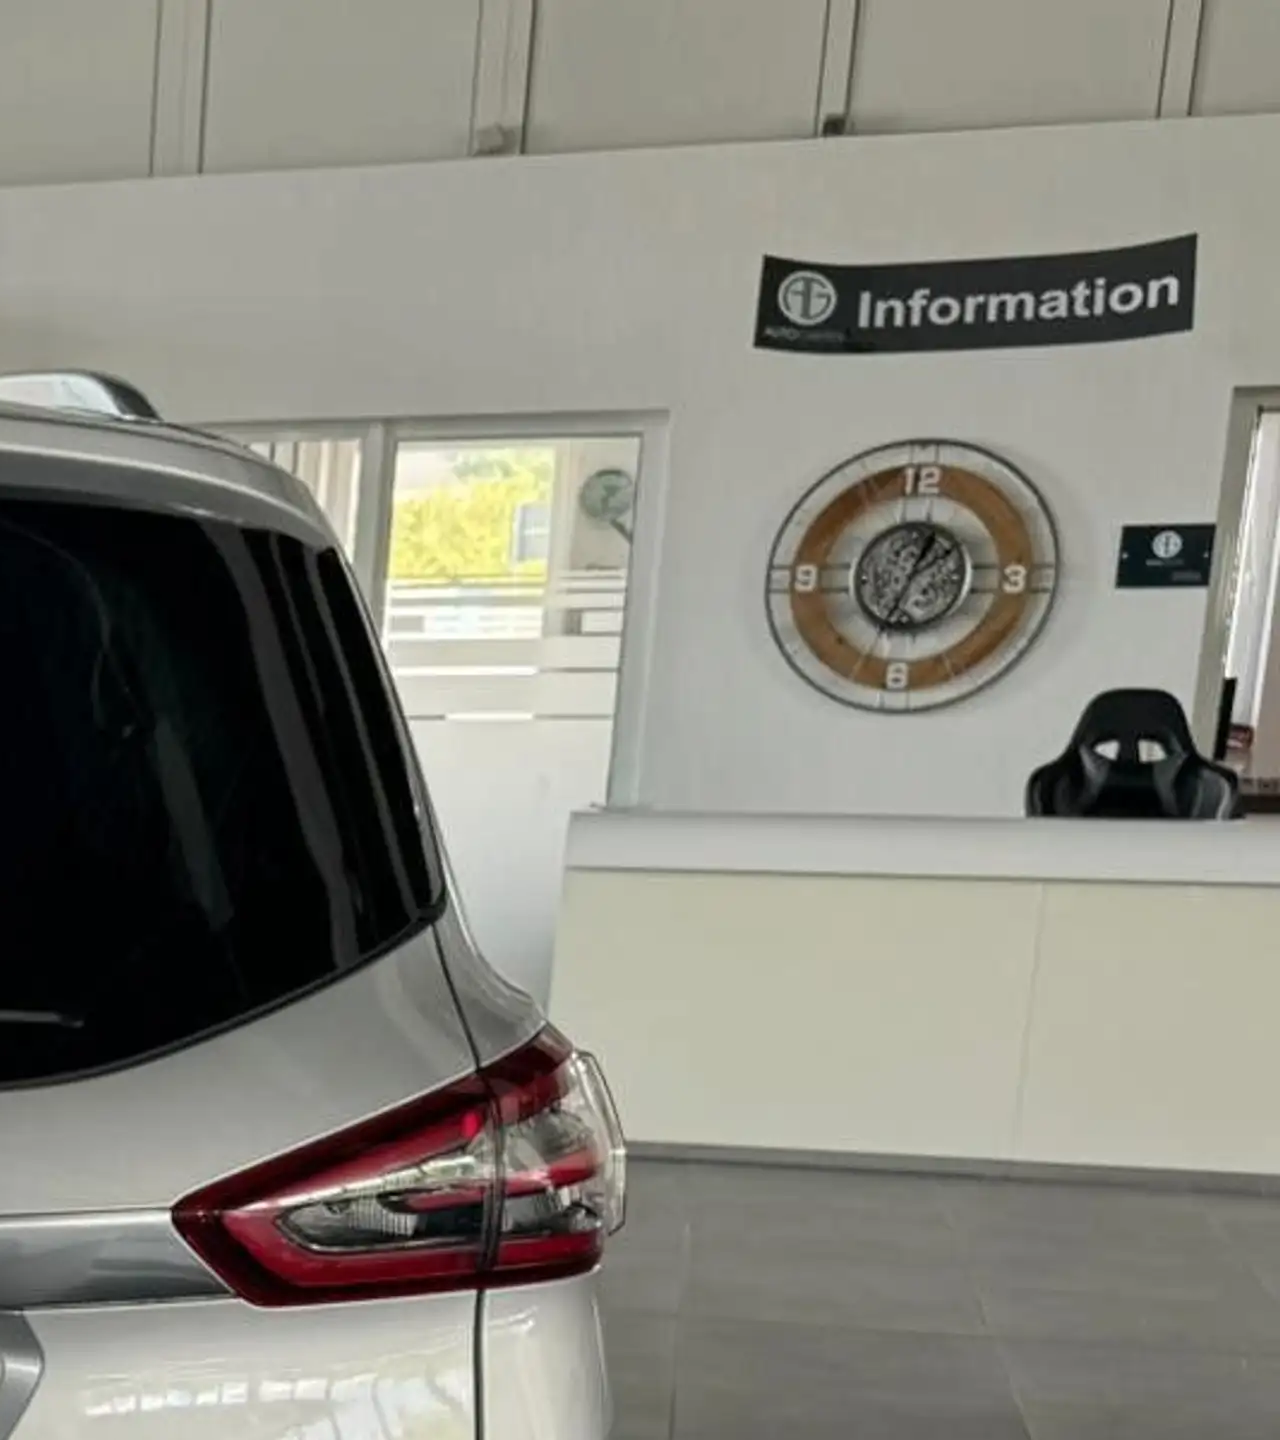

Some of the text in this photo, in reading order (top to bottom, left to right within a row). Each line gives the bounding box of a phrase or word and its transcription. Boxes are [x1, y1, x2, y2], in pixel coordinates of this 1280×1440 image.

[857, 275, 1181, 328] Information
[903, 466, 942, 494] 12
[794, 564, 818, 592] 9
[1003, 564, 1027, 594] 3
[886, 661, 909, 689] 6
